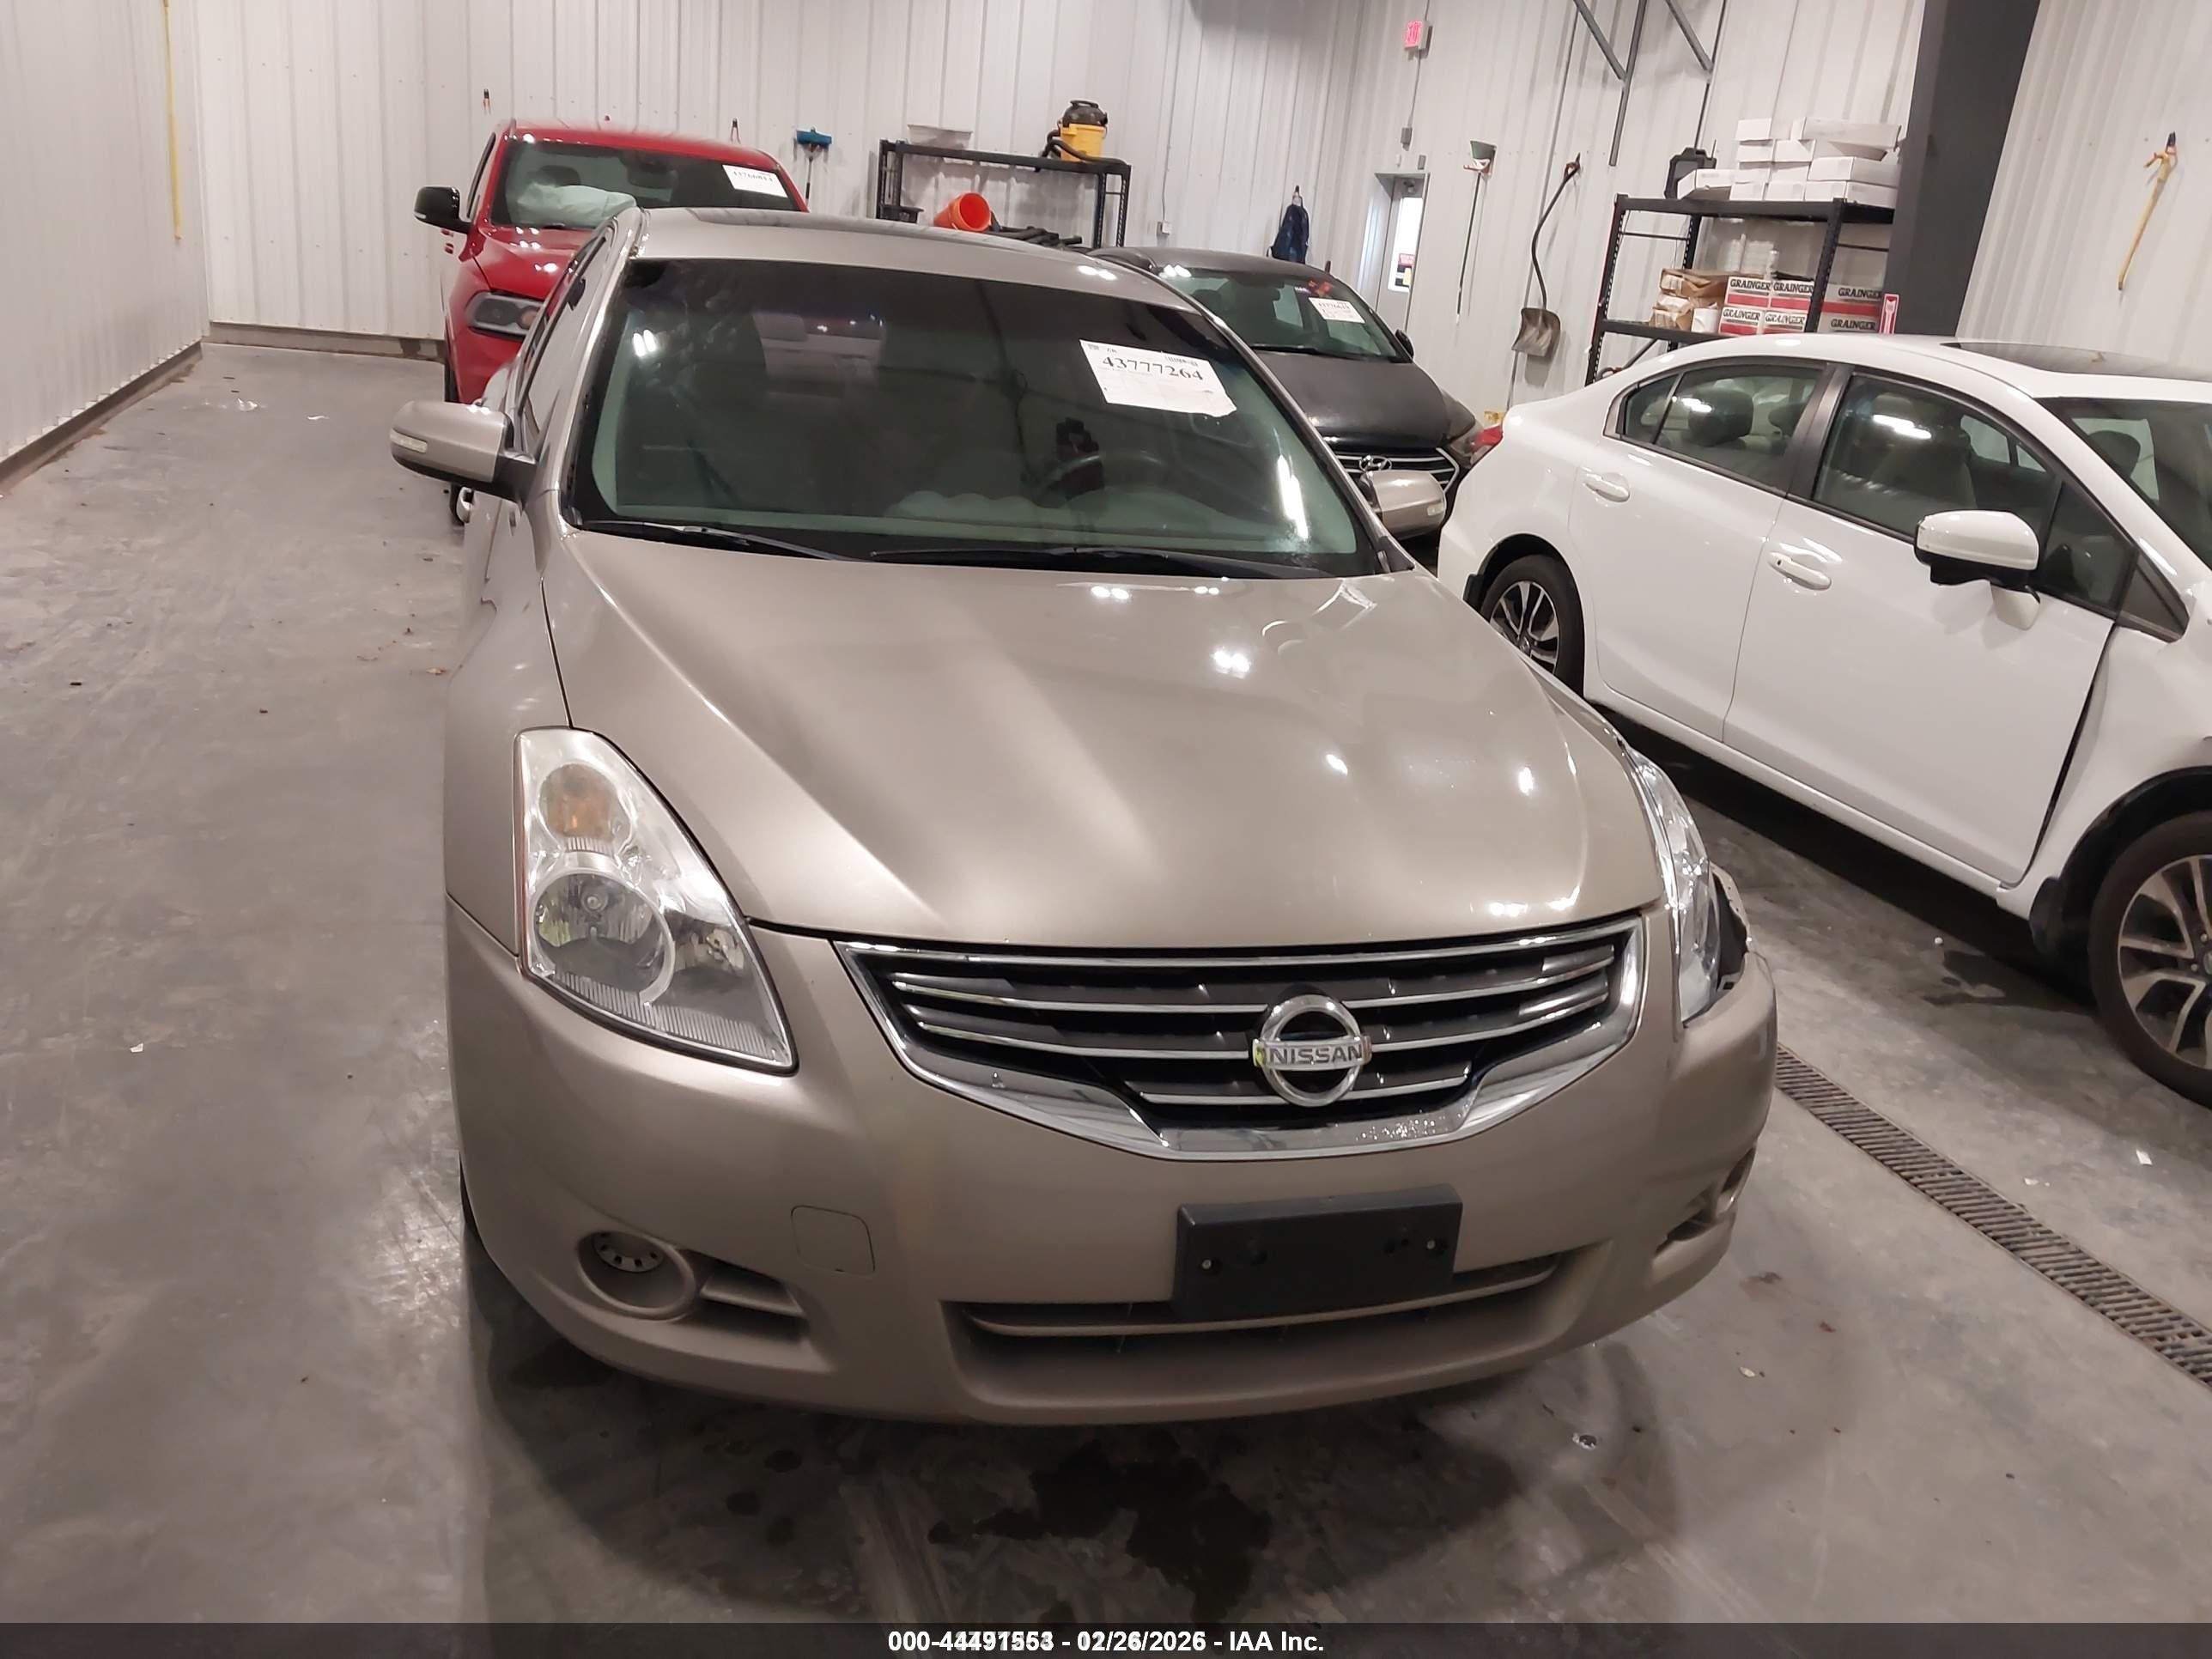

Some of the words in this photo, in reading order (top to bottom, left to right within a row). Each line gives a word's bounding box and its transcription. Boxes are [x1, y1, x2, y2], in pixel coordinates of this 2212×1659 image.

[1729, 279, 1771, 291] GRAINGER
[1773, 282, 1814, 293] GRAINGER
[1838, 288, 1882, 299] GRAINGER
[1723, 309, 1760, 320] GRAINGER
[1765, 313, 1805, 325] GRAINGER
[1831, 319, 1875, 331] GRAINGER
[1103, 356, 1203, 380] 43777264
[1269, 1044, 1363, 1066] NISSAN
